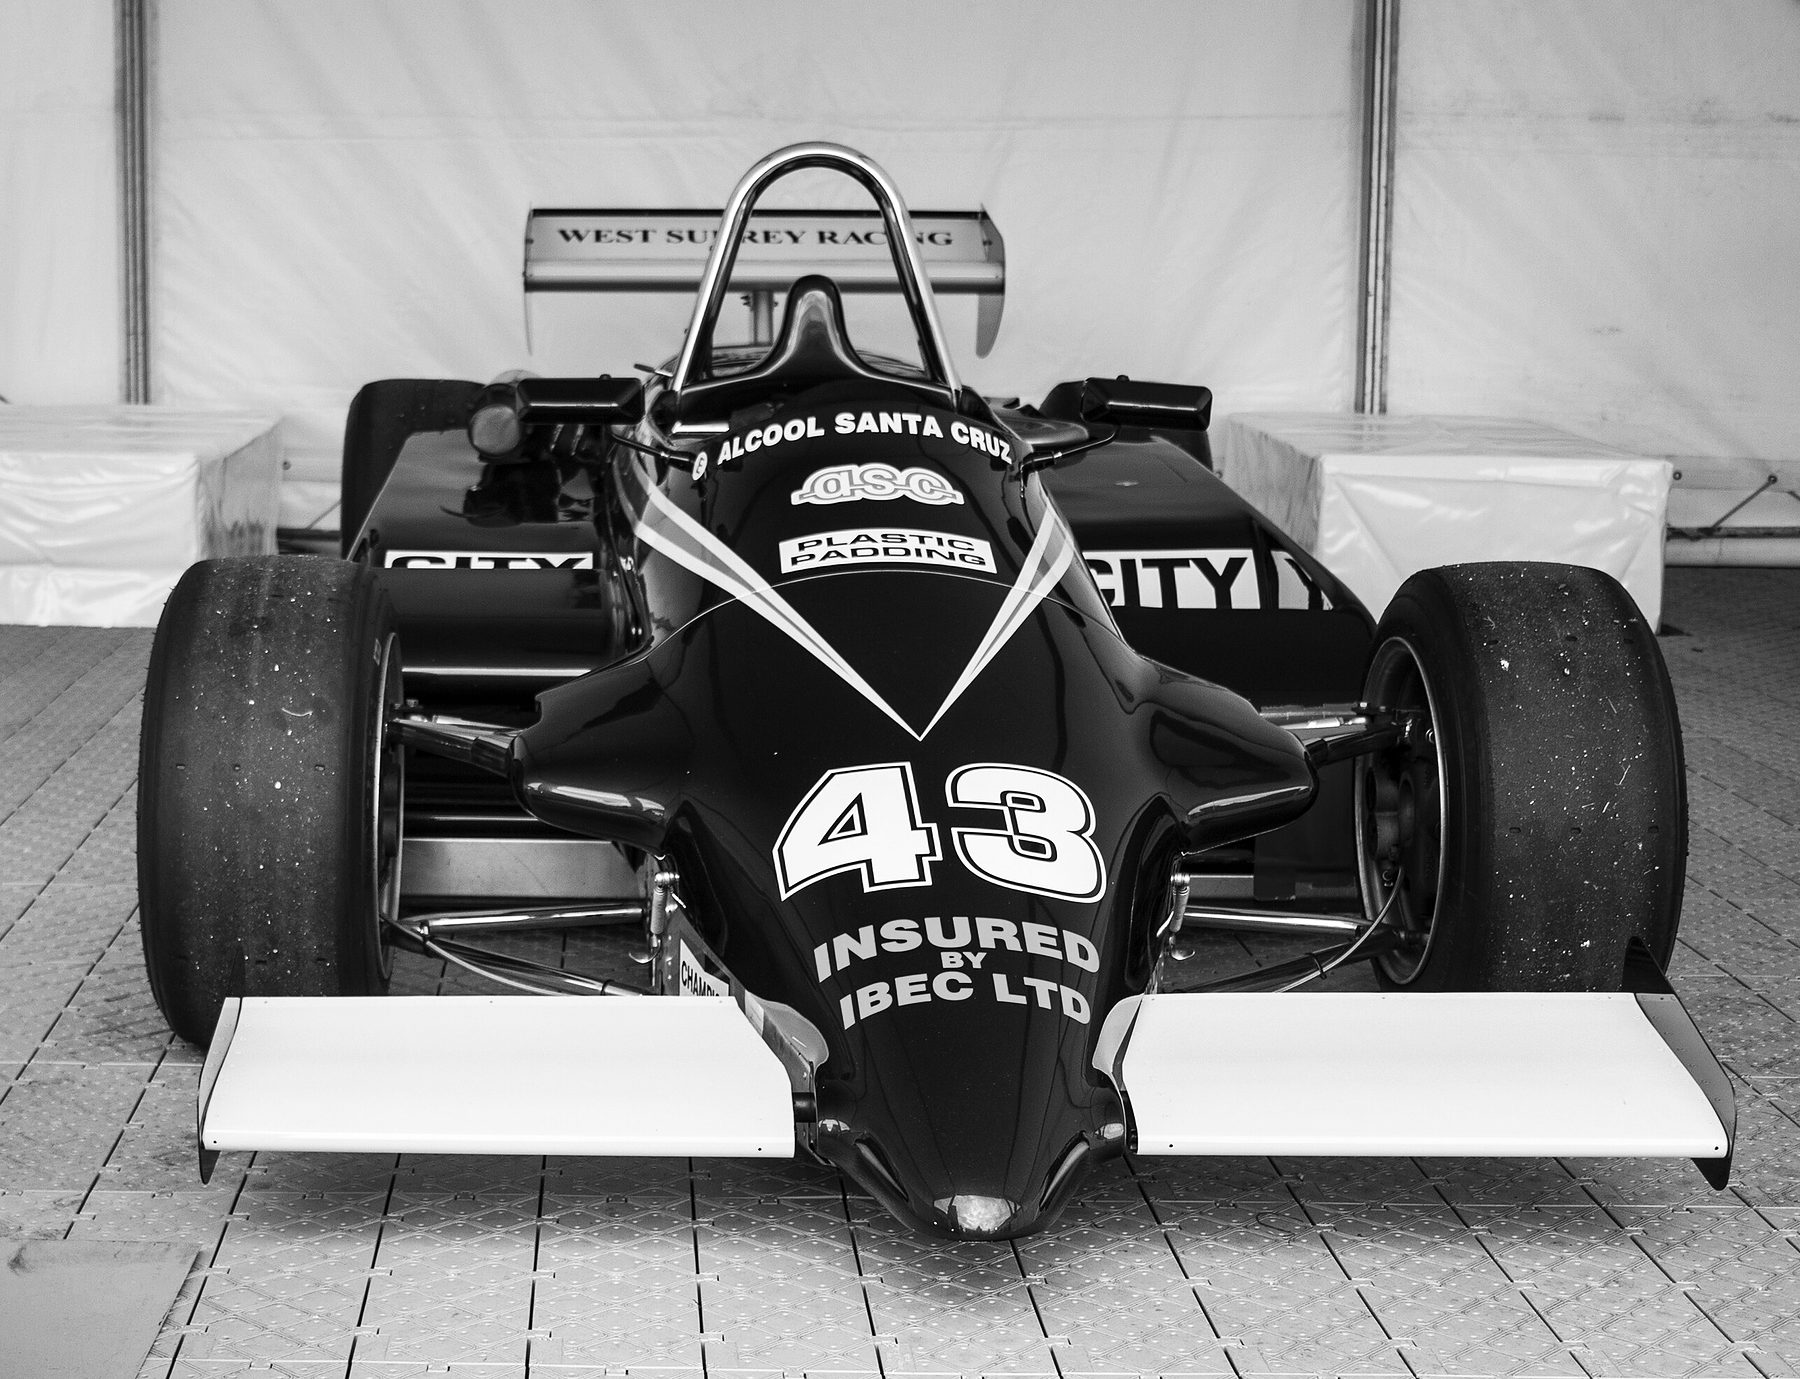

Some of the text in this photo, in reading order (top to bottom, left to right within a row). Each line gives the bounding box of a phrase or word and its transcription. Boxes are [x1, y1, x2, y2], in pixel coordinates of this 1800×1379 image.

[557, 228, 953, 247] WEST SUREY RACG
[717, 411, 1012, 465] ALCOOL SANTA CRUZ
[790, 547, 987, 567] PADDING
[797, 533, 975, 551] PLASTIC
[772, 761, 1107, 904] 43
[814, 916, 1100, 983] INSURED
[940, 951, 987, 969] BY
[681, 960, 720, 997] CHAMP
[839, 971, 1091, 1030] IBEC LTD
